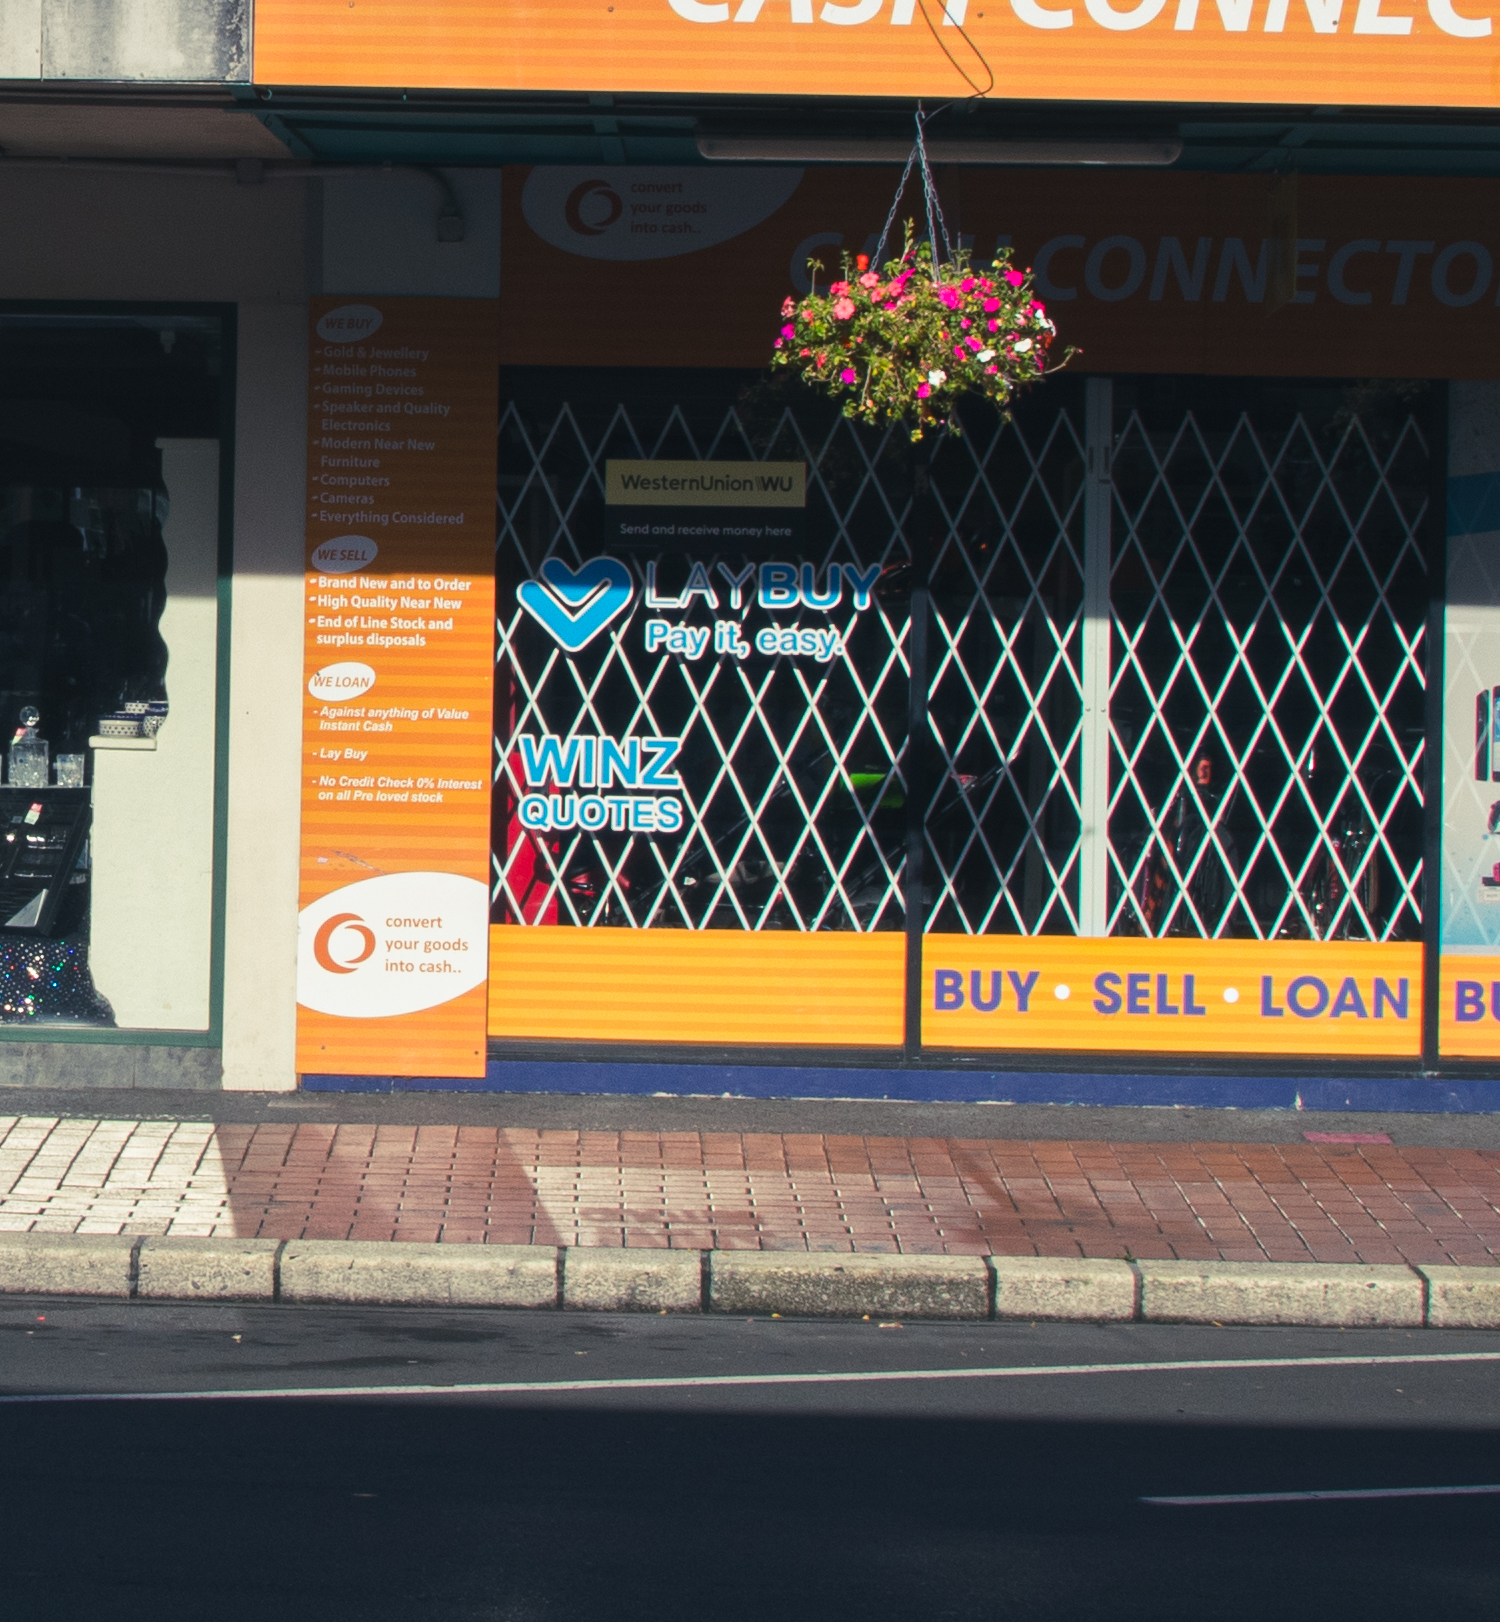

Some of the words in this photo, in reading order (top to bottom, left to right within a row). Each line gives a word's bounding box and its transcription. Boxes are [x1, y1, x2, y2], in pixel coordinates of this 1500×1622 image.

[356, 347, 366, 358] &
[370, 346, 430, 362] Jewellery
[321, 418, 391, 432] Electronics
[391, 511, 464, 525] Considered
[620, 523, 649, 535] Send
[652, 523, 675, 535] and
[677, 523, 720, 536] receive
[723, 526, 762, 538] money
[765, 525, 792, 537] here
[359, 577, 388, 589] New
[390, 577, 414, 590] and
[417, 579, 431, 590] to
[433, 577, 472, 592] Order
[350, 595, 398, 611] Quality
[400, 596, 432, 609] Near
[433, 597, 463, 610] New
[344, 615, 360, 628] of
[360, 616, 388, 629] Line
[390, 617, 426, 630] Stock
[427, 617, 453, 631] and
[316, 633, 364, 647] surplus
[366, 634, 426, 648] disposals
[646, 619, 711, 659] Pay
[714, 620, 751, 659] it,
[756, 626, 844, 662] easy.
[313, 676, 333, 687] WE
[335, 676, 371, 688] LOAN
[319, 720, 360, 731] Instant
[362, 721, 393, 732] Cash
[343, 748, 368, 761] Buy
[518, 734, 682, 790] WINZ
[520, 793, 683, 833] QUOTES
[385, 917, 442, 929] convert
[384, 939, 420, 953] your
[423, 938, 469, 954] goods
[385, 959, 415, 973] into
[933, 968, 1041, 1014] BUY
[1092, 970, 1206, 1018] SELL
[1259, 974, 1409, 1022] LOAN
